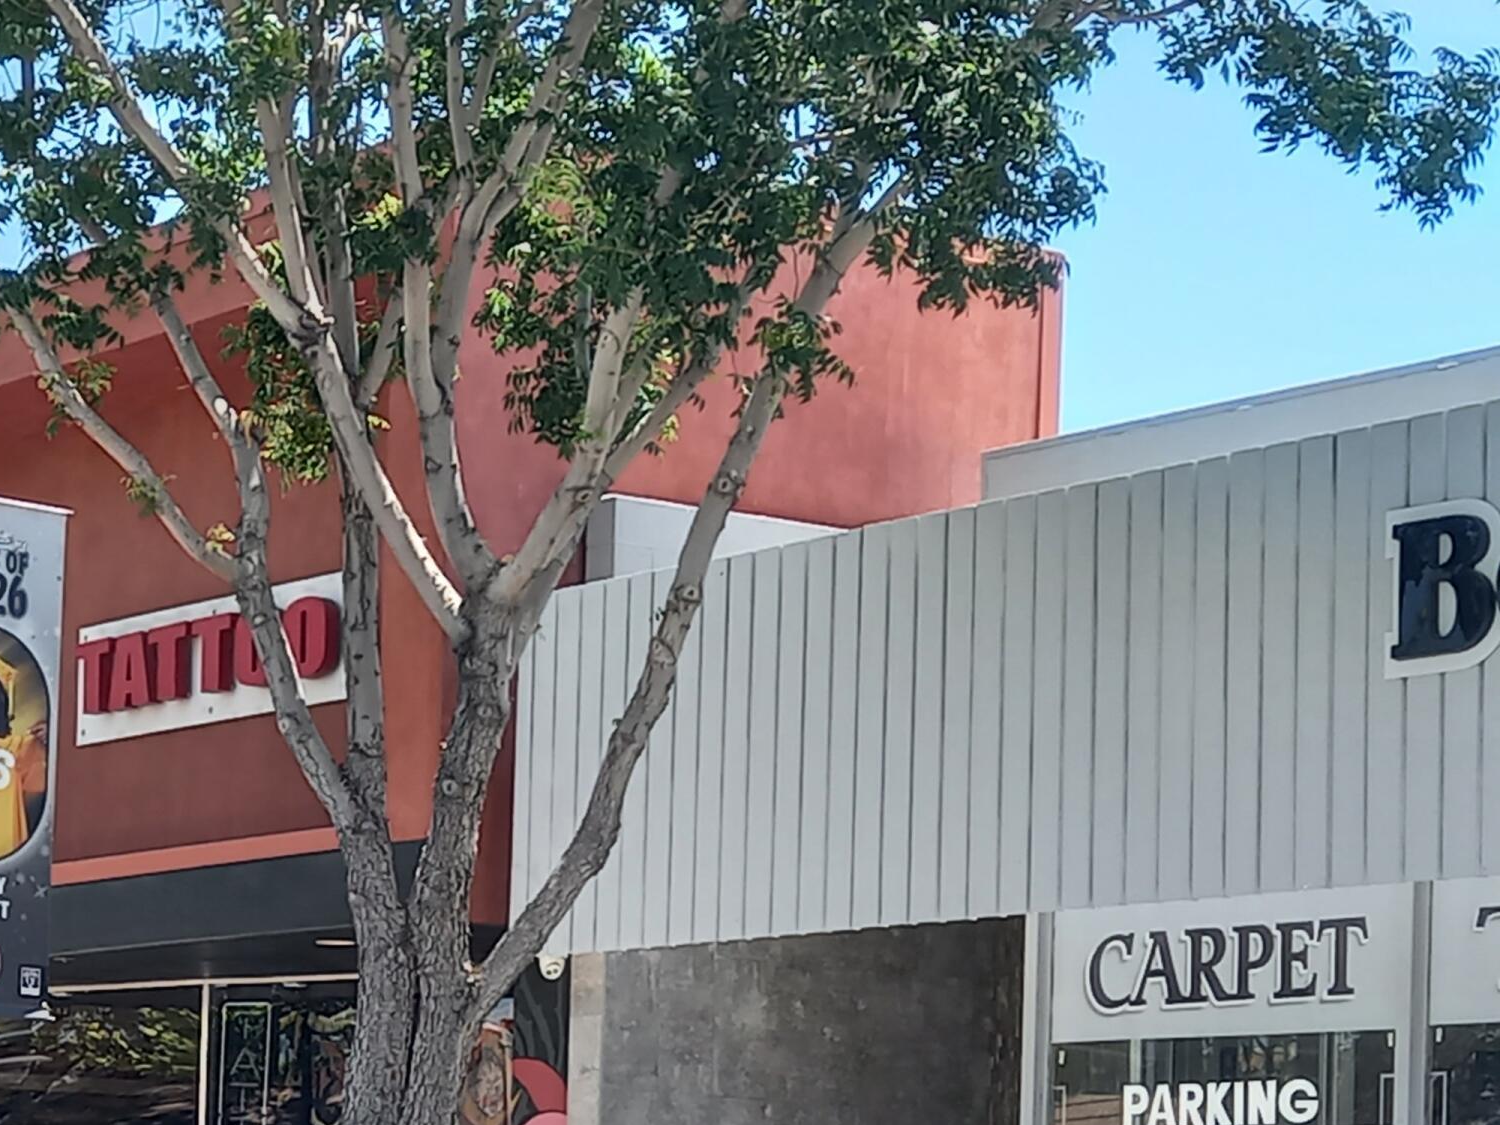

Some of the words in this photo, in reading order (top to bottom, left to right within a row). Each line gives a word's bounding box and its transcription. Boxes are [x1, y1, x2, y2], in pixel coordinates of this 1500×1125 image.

[5, 549, 29, 576] OF
[1390, 514, 1500, 661] B
[77, 596, 340, 715] TATTOO
[1087, 916, 1367, 1014] CARPET
